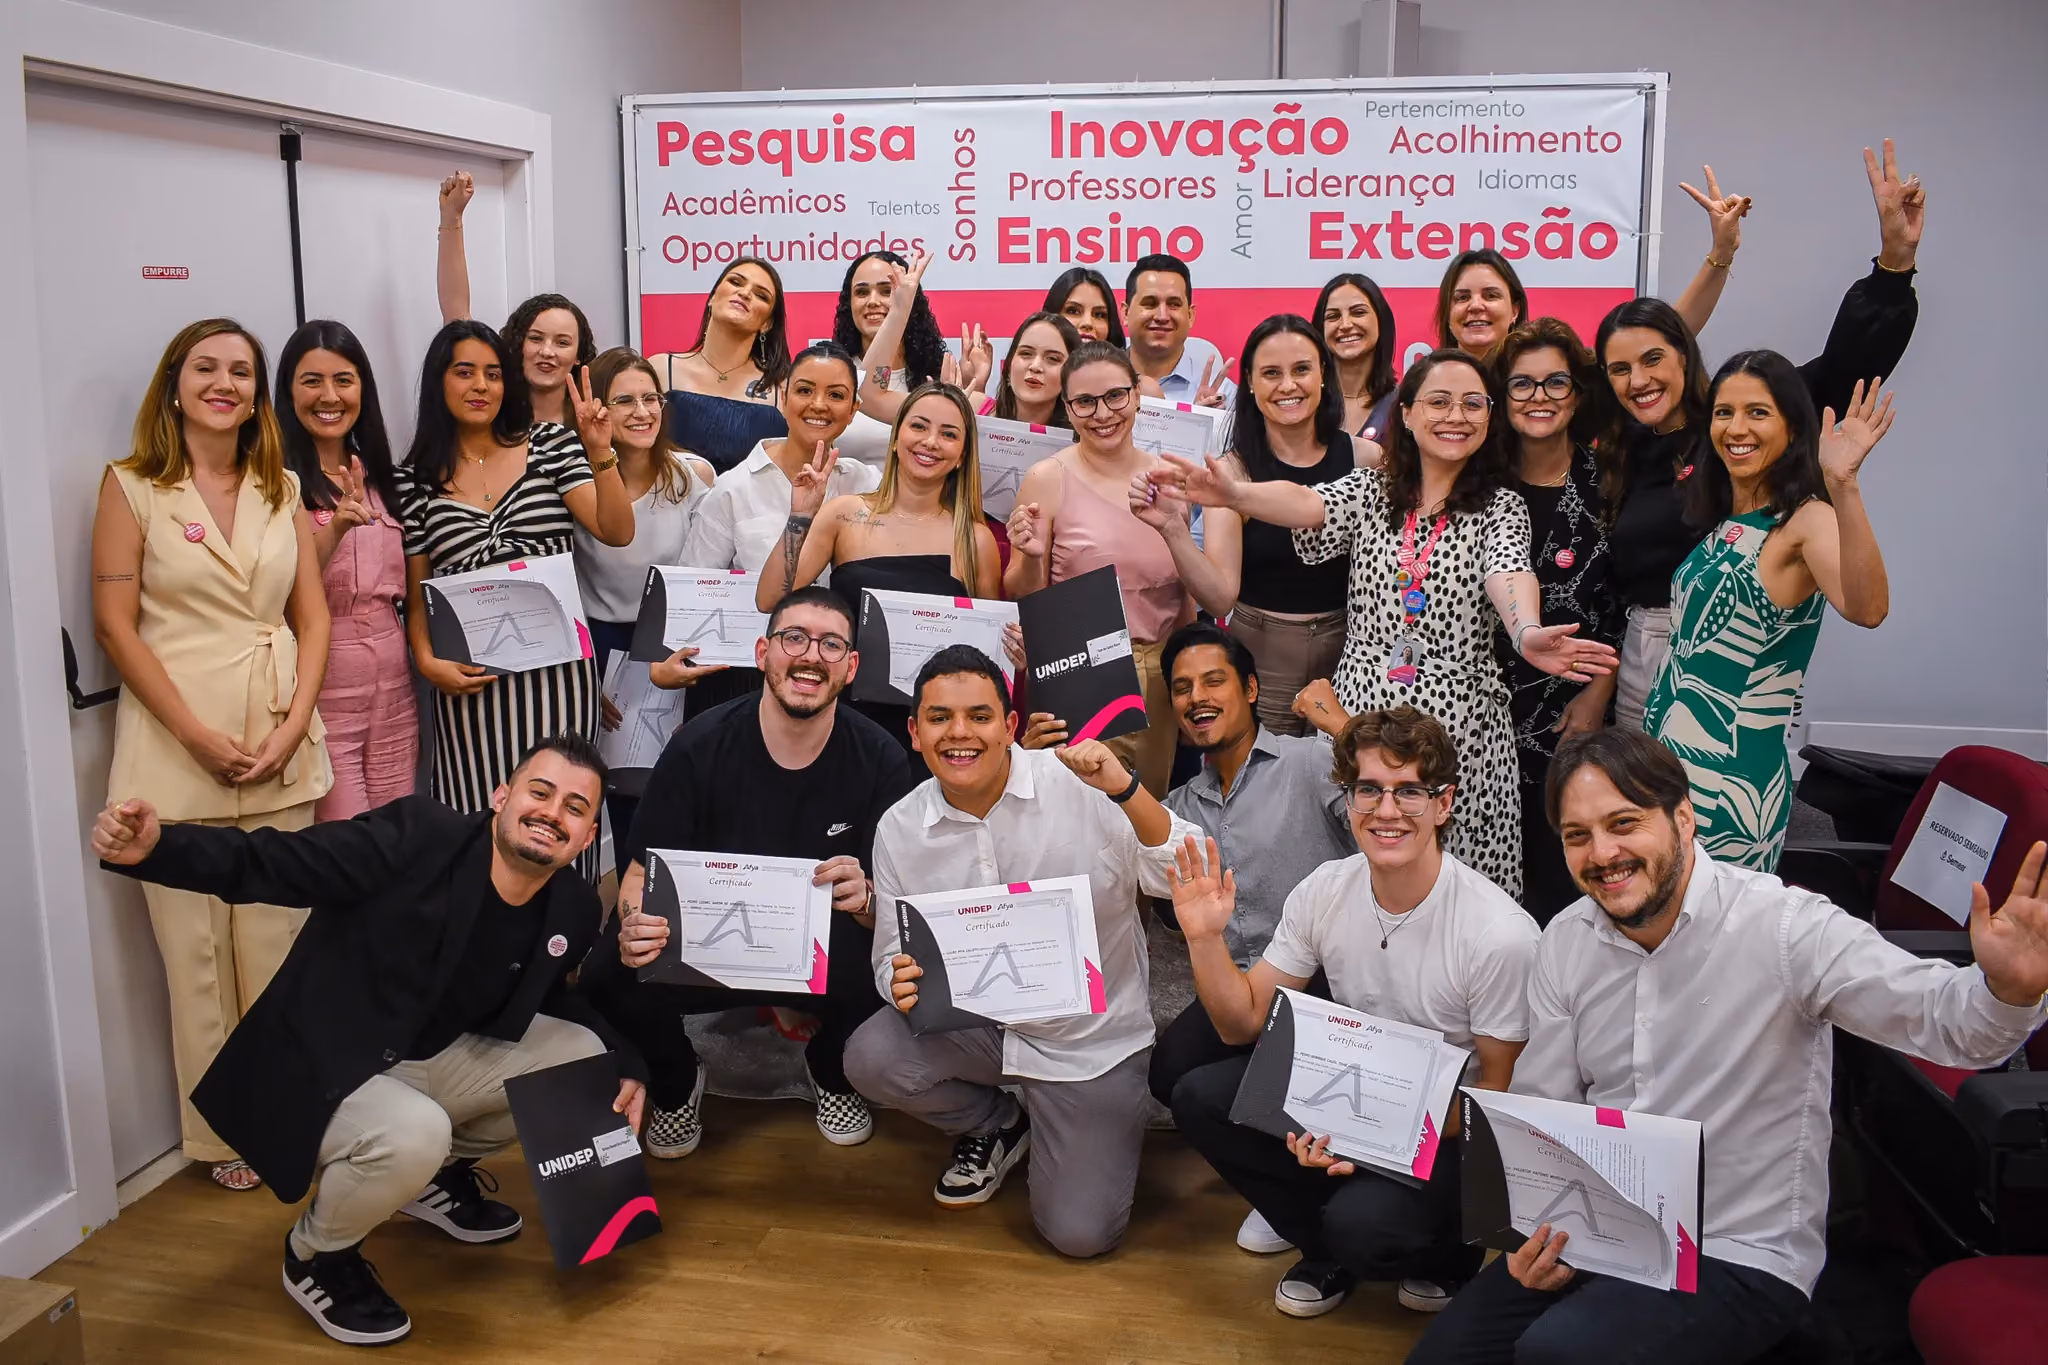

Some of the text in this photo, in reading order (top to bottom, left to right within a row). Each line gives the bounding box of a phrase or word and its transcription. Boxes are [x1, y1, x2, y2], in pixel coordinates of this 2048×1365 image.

[1365, 100, 1525, 119] Pertencimento
[657, 113, 916, 177] Pesquisa
[1050, 102, 1349, 173] Inovação
[1389, 124, 1622, 154] Acolhimento
[1009, 169, 1217, 201] Professores
[1264, 167, 1456, 206] Liderança
[1478, 168, 1578, 190] Idiomas
[662, 188, 847, 217] Acadêmicos
[947, 127, 976, 263] Sonhos
[868, 200, 941, 216] Talentos
[1230, 181, 1253, 259] Amor
[998, 212, 1204, 264] Ensino
[1308, 207, 1619, 261] Extensão
[662, 231, 925, 271] Oportunidades
[143, 267, 188, 276] EMPURRE
[989, 433, 1015, 442] UNIDEP
[912, 609, 940, 619] UNIDEP
[915, 624, 952, 635] Certificado
[1035, 651, 1088, 680] UNIDEP
[1929, 820, 1989, 861] RESERVADO SEMEANDO
[705, 861, 759, 871] UNIDEP Afya
[1946, 854, 1967, 872] Semear
[709, 877, 753, 888] Certificado
[957, 903, 1014, 915] UNIDEP Afya
[965, 919, 1010, 933] Certificado
[1327, 1015, 1383, 1034] UNIDEP Afya
[1328, 1033, 1373, 1051] Certificado
[538, 1147, 594, 1177] UNIDEP
